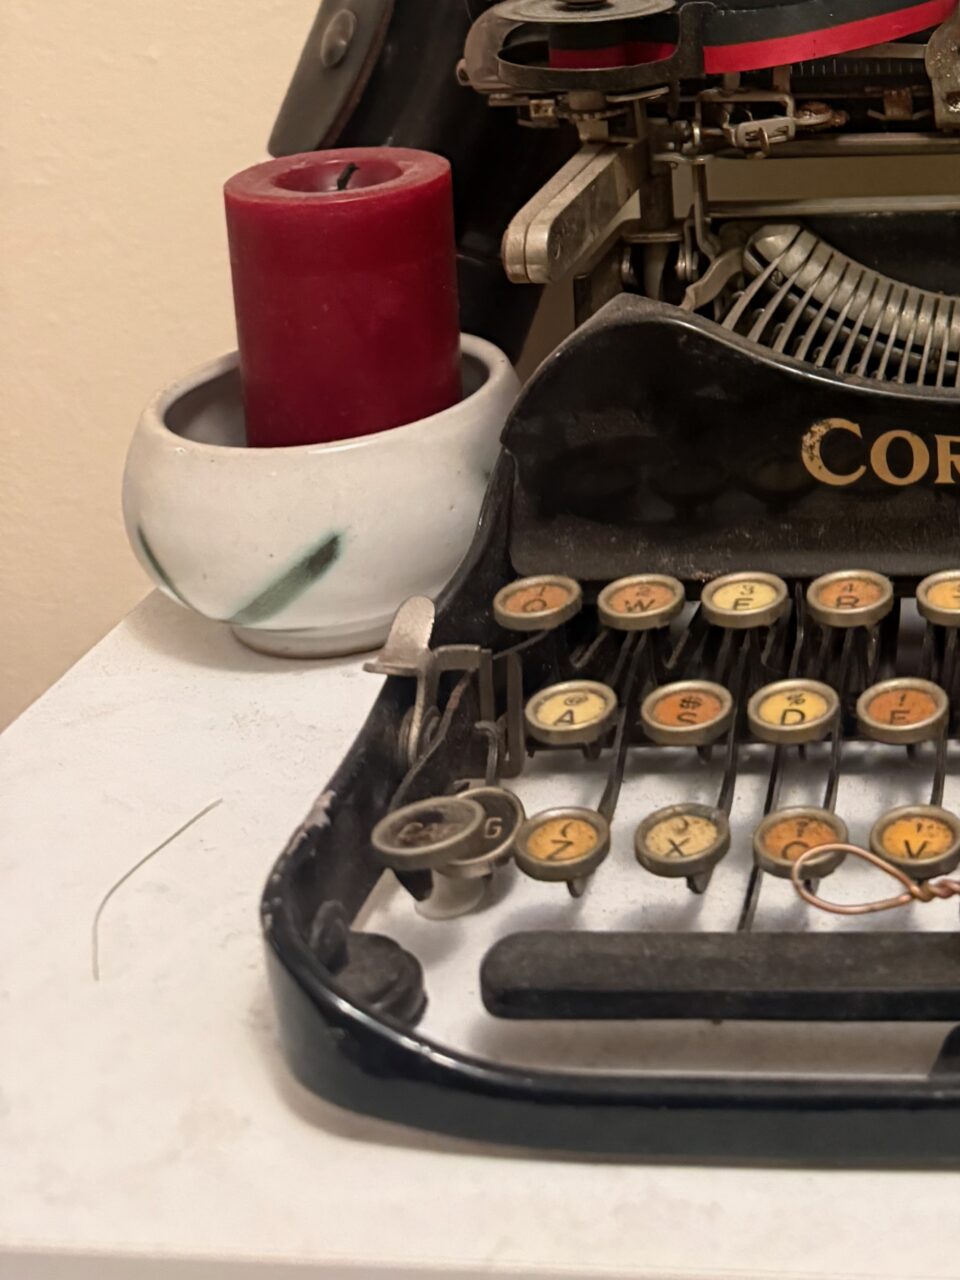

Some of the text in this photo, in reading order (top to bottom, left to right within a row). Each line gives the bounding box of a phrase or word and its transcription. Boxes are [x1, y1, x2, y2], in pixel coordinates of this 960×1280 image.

[624, 598, 656, 613] W
[732, 597, 755, 611] E
[835, 595, 860, 608] R
[552, 709, 578, 728] A
[676, 712, 699, 726] S
[780, 709, 806, 726] D
[545, 839, 574, 860] Z
[665, 837, 692, 857] X
[904, 839, 928, 858] V
